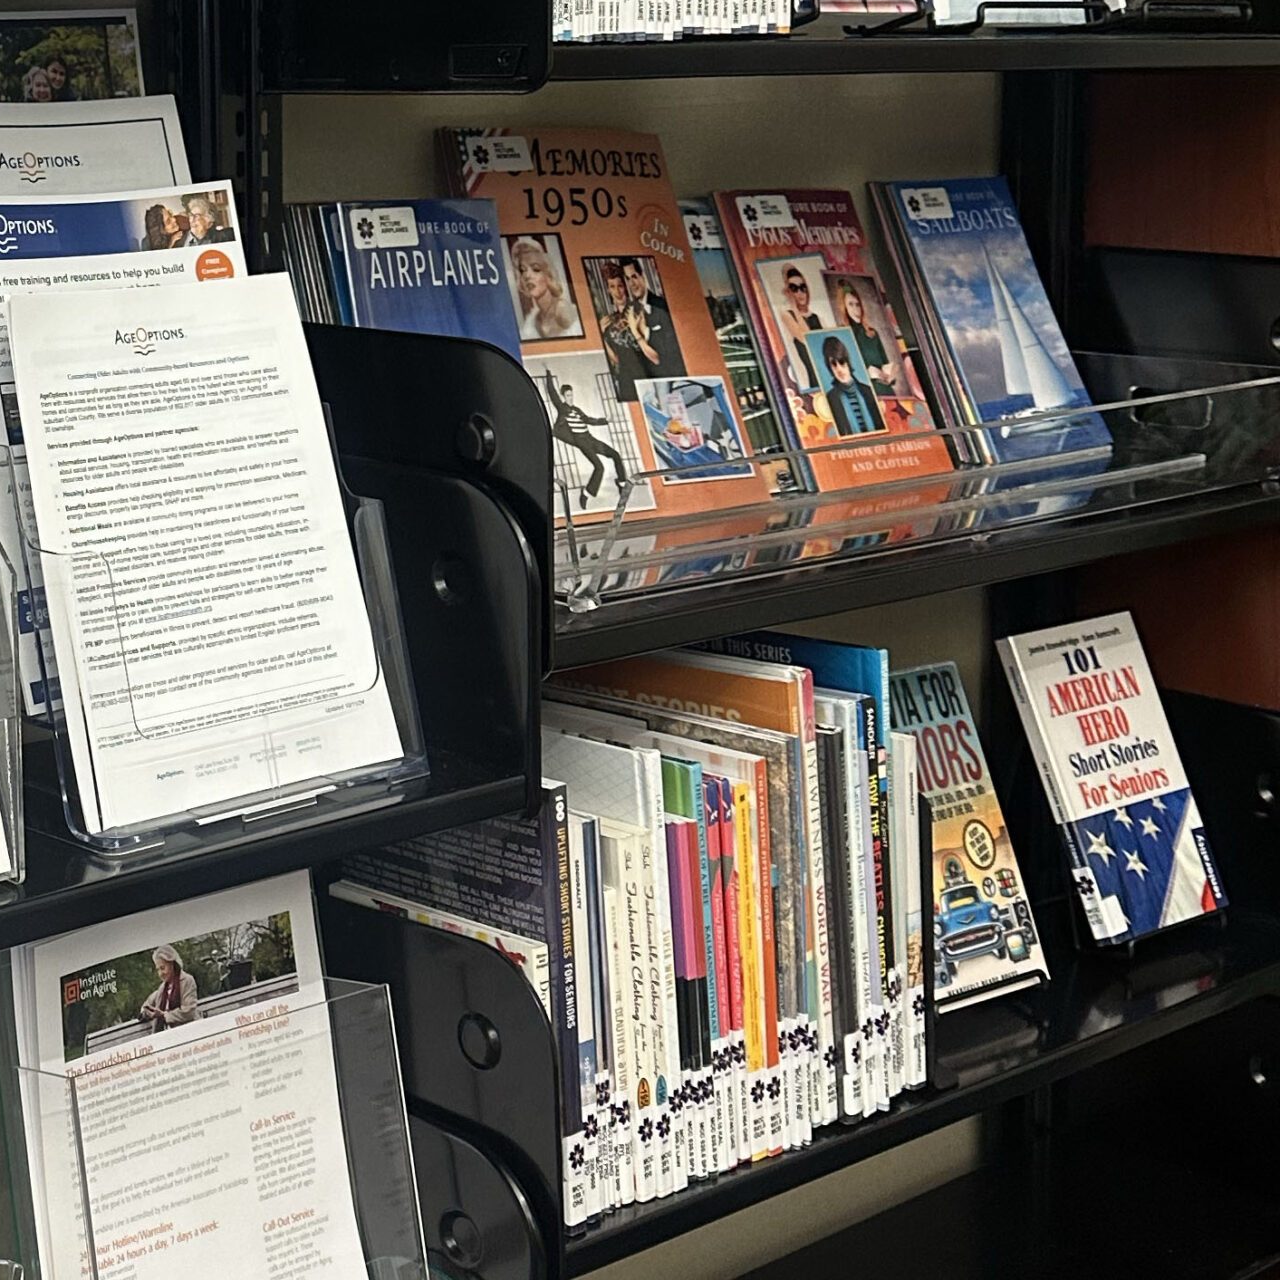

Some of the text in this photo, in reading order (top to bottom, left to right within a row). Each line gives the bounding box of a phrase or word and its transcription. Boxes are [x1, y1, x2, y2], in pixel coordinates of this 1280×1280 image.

[522, 188, 629, 226] 1950s
[370, 249, 501, 289] AIRPLANES
[1063, 646, 1102, 675] 101
[1046, 666, 1141, 718] AMERICAN
[1076, 707, 1130, 745] HERO
[1070, 737, 1159, 777] Short Stories
[1078, 767, 1169, 809] For Seniors
[79, 969, 116, 989] Institute
[81, 981, 117, 1000] on Aging
